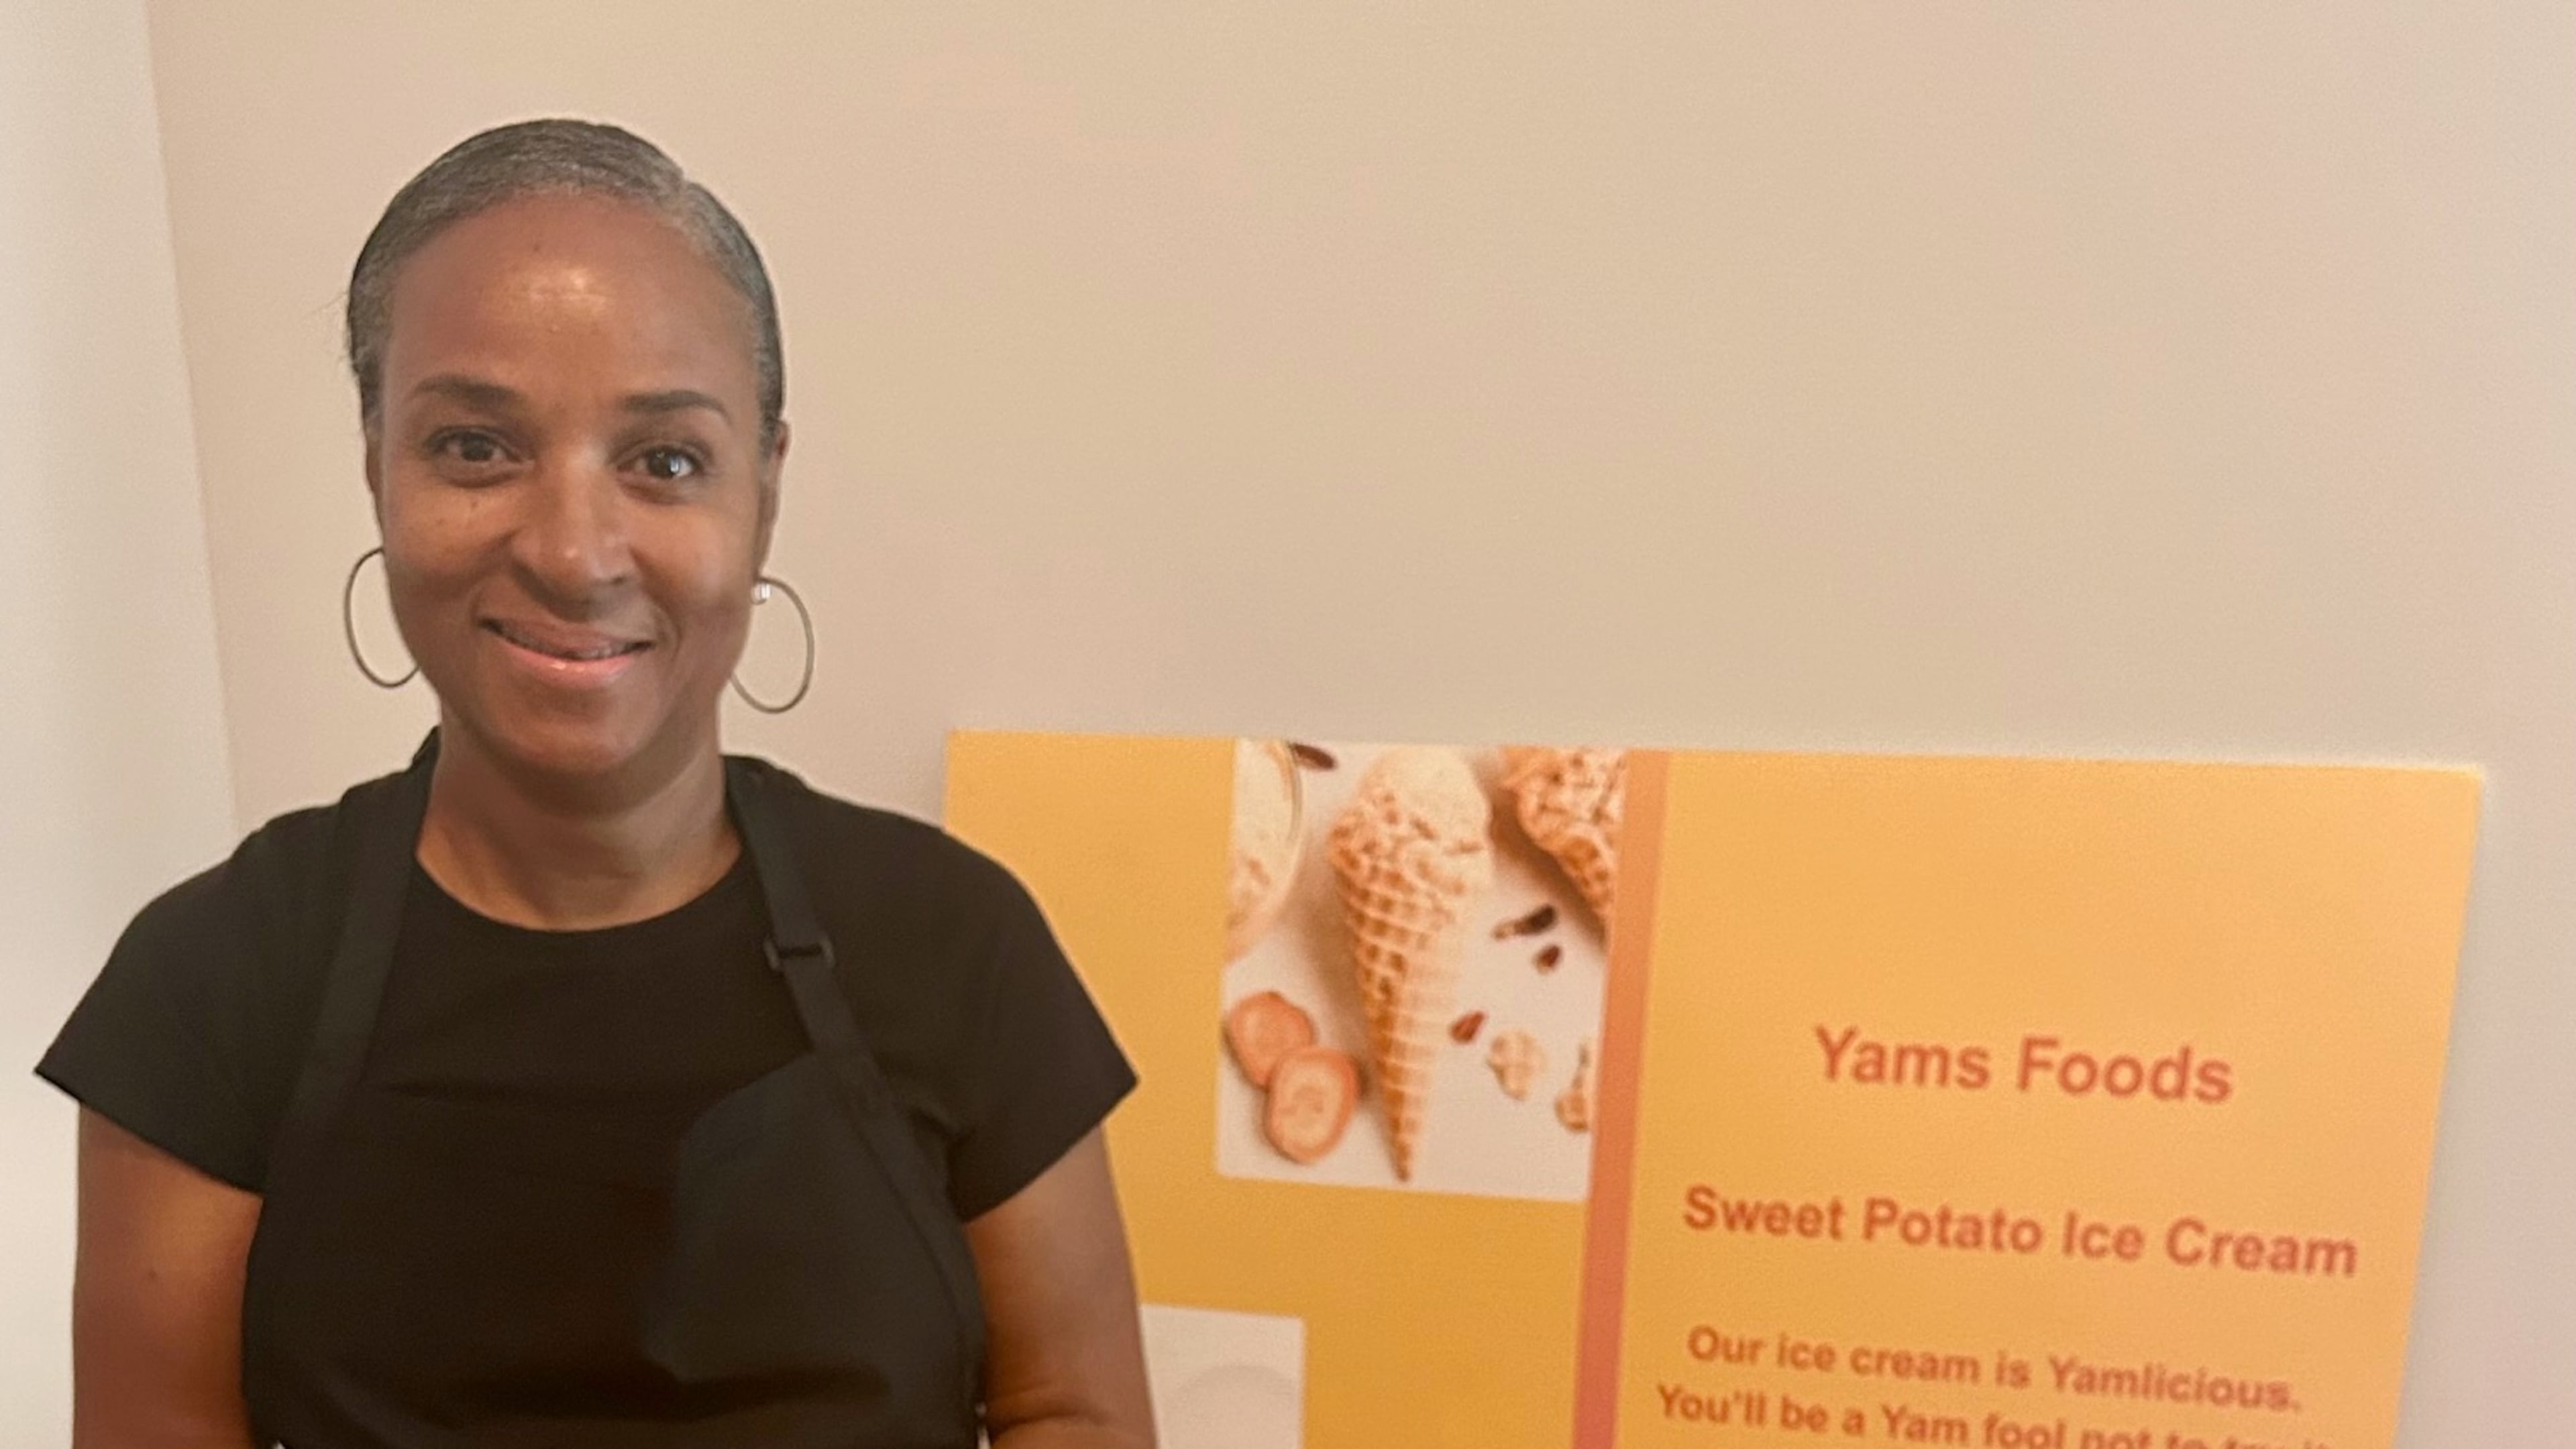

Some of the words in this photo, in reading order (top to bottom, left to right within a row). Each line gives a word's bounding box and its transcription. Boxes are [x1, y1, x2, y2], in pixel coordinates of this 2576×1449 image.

[1814, 1024, 1992, 1090] Yams
[2017, 1036, 2233, 1104] Foods
[1682, 1184, 1846, 1240] Sweet
[1862, 1197, 2044, 1254] Potato
[2062, 1210, 2145, 1262] Ice
[2165, 1216, 2358, 1277] Cream
[1687, 1326, 1764, 1366] Our
[1776, 1332, 1837, 1372] ice
[1849, 1347, 1981, 1384] cream
[1995, 1350, 2031, 1389] is
[2048, 1356, 2302, 1411] Yamlicious.
[1657, 1383, 1767, 1427] You'll
[1780, 1394, 1829, 1434] be
[1841, 1409, 1866, 1437] a
[1881, 1404, 1969, 1446] Yam
[1984, 1413, 2065, 1449] fool
